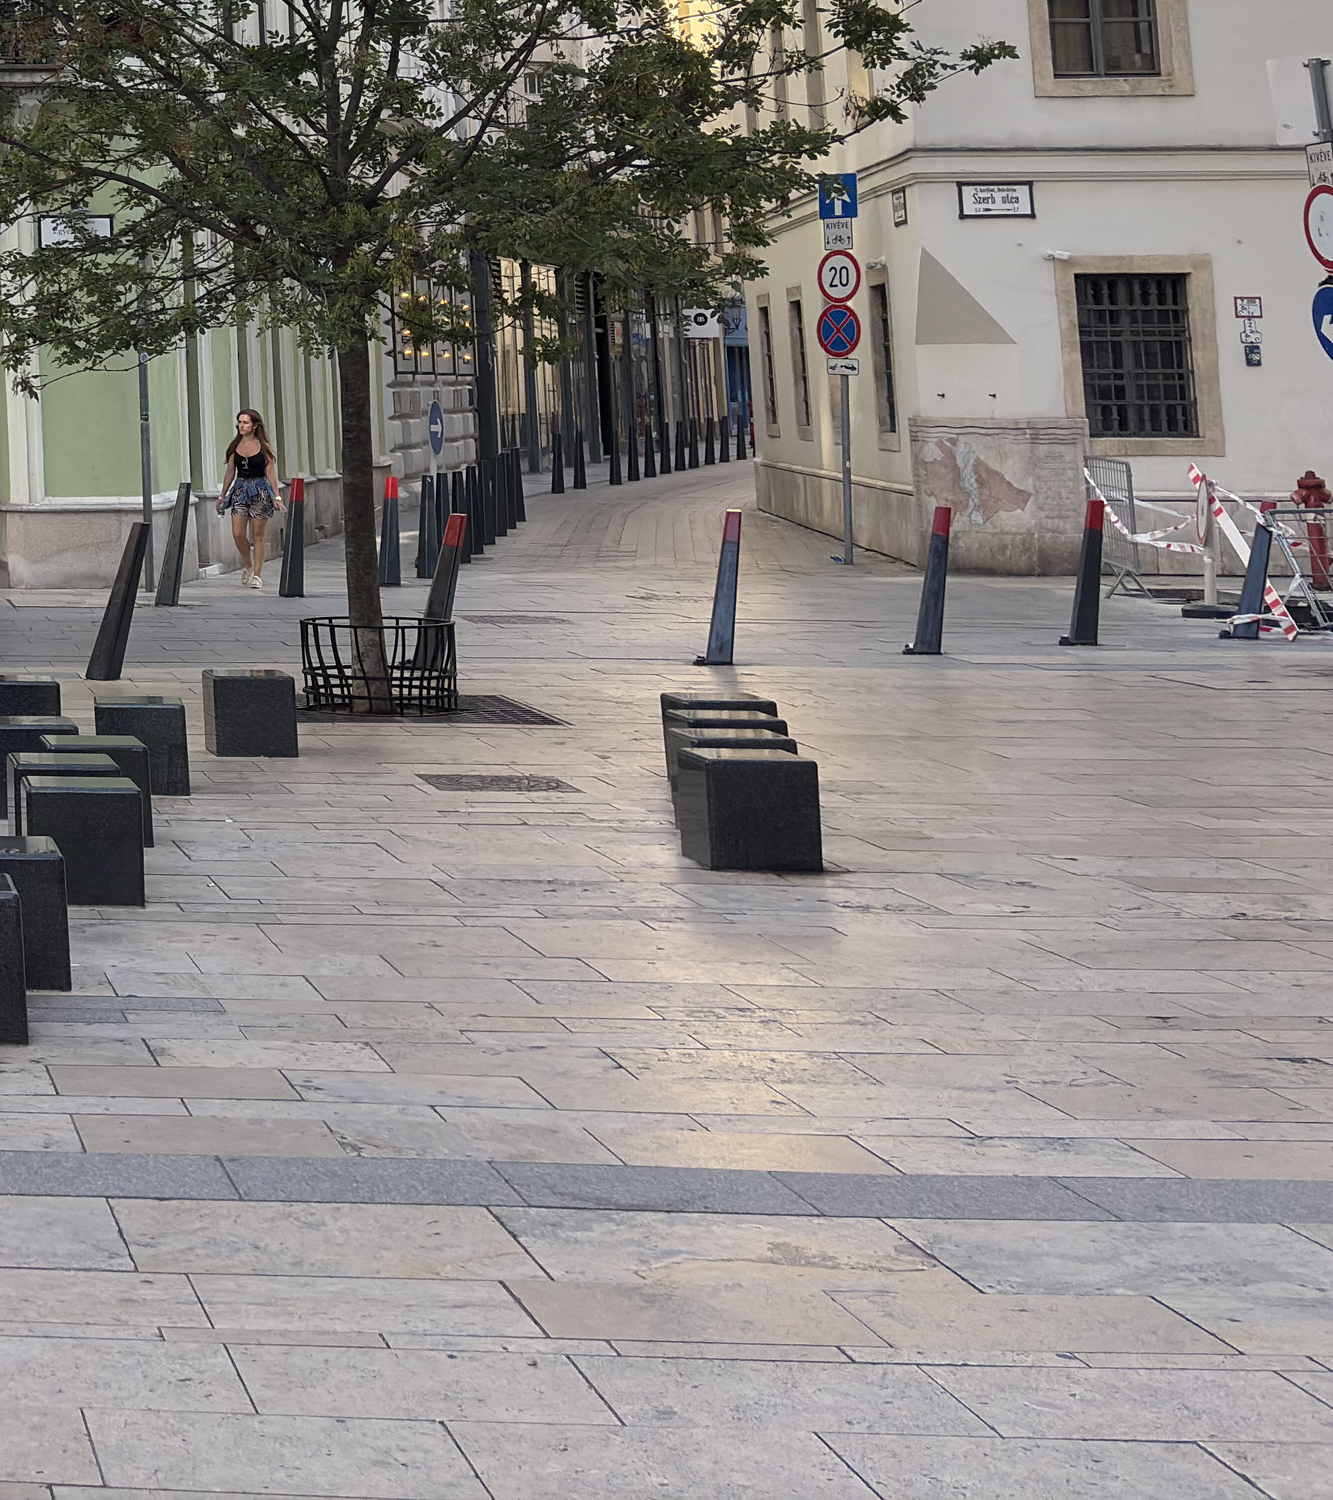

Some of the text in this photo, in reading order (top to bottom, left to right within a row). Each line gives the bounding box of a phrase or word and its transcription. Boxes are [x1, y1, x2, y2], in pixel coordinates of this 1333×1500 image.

[972, 192, 996, 205] Szerb
[826, 220, 849, 230] KIVÉVE
[828, 265, 850, 288] 20
